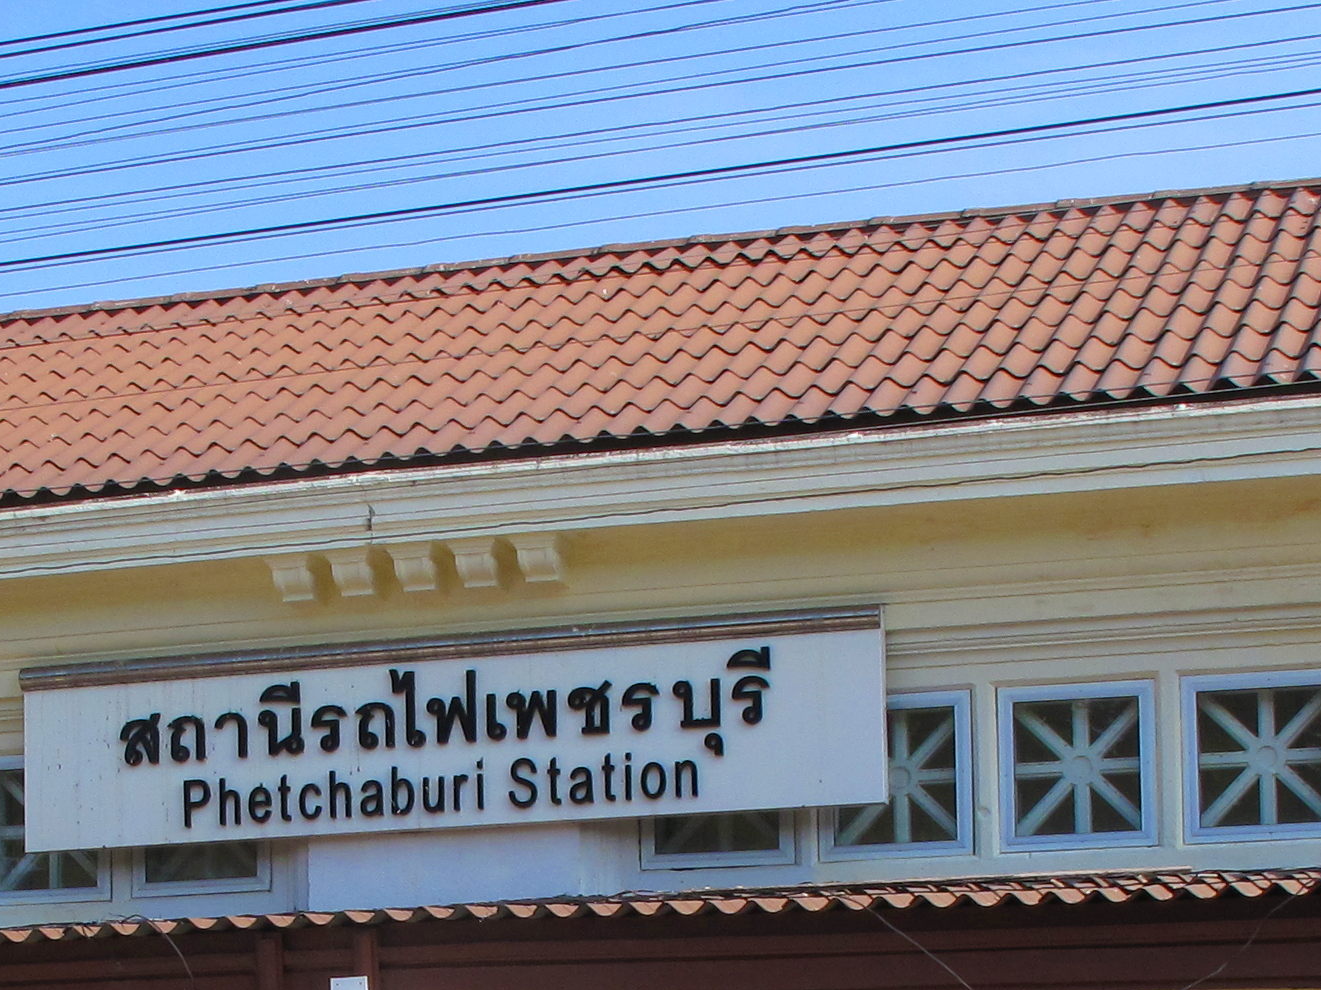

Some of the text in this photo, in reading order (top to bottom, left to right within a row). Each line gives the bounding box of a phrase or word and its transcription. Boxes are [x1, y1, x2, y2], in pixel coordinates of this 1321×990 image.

[119, 648, 772, 765] สถานีรถไฟเพชรบุรี
[182, 752, 701, 829] Phetchaburi Station
